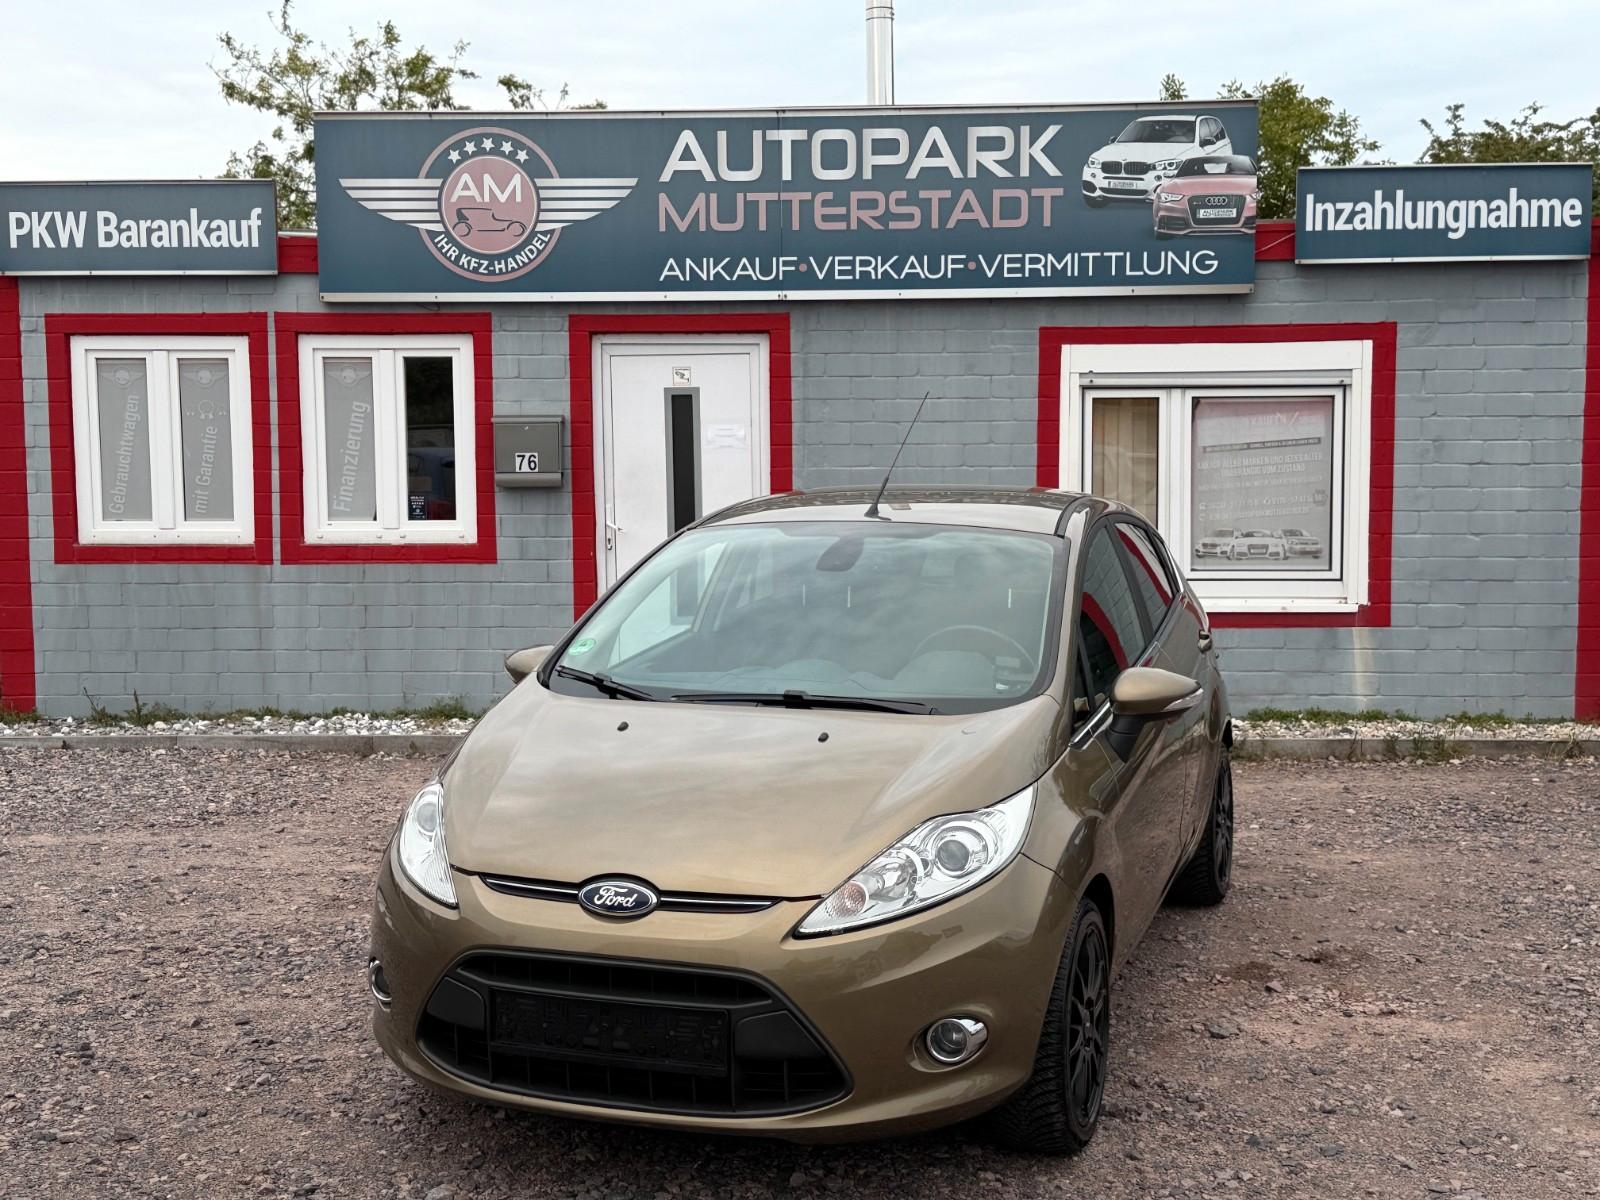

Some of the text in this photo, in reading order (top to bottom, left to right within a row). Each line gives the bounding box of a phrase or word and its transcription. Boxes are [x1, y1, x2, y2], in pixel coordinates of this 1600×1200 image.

[658, 124, 1063, 182] AUTOPARK
[450, 173, 521, 203] AM
[658, 187, 1064, 232] MUTTERSTADT
[8, 207, 262, 249] PKW Barankauf
[1305, 187, 1583, 240] Inzahlungnahme
[434, 232, 551, 274] IHR KFZ-HANDEL
[109, 394, 141, 513] Gebrauchtwagen
[193, 425, 218, 513] mit Garantie
[332, 401, 372, 512] Finanzierung
[516, 454, 538, 471] 76
[594, 886, 637, 907] Ford
